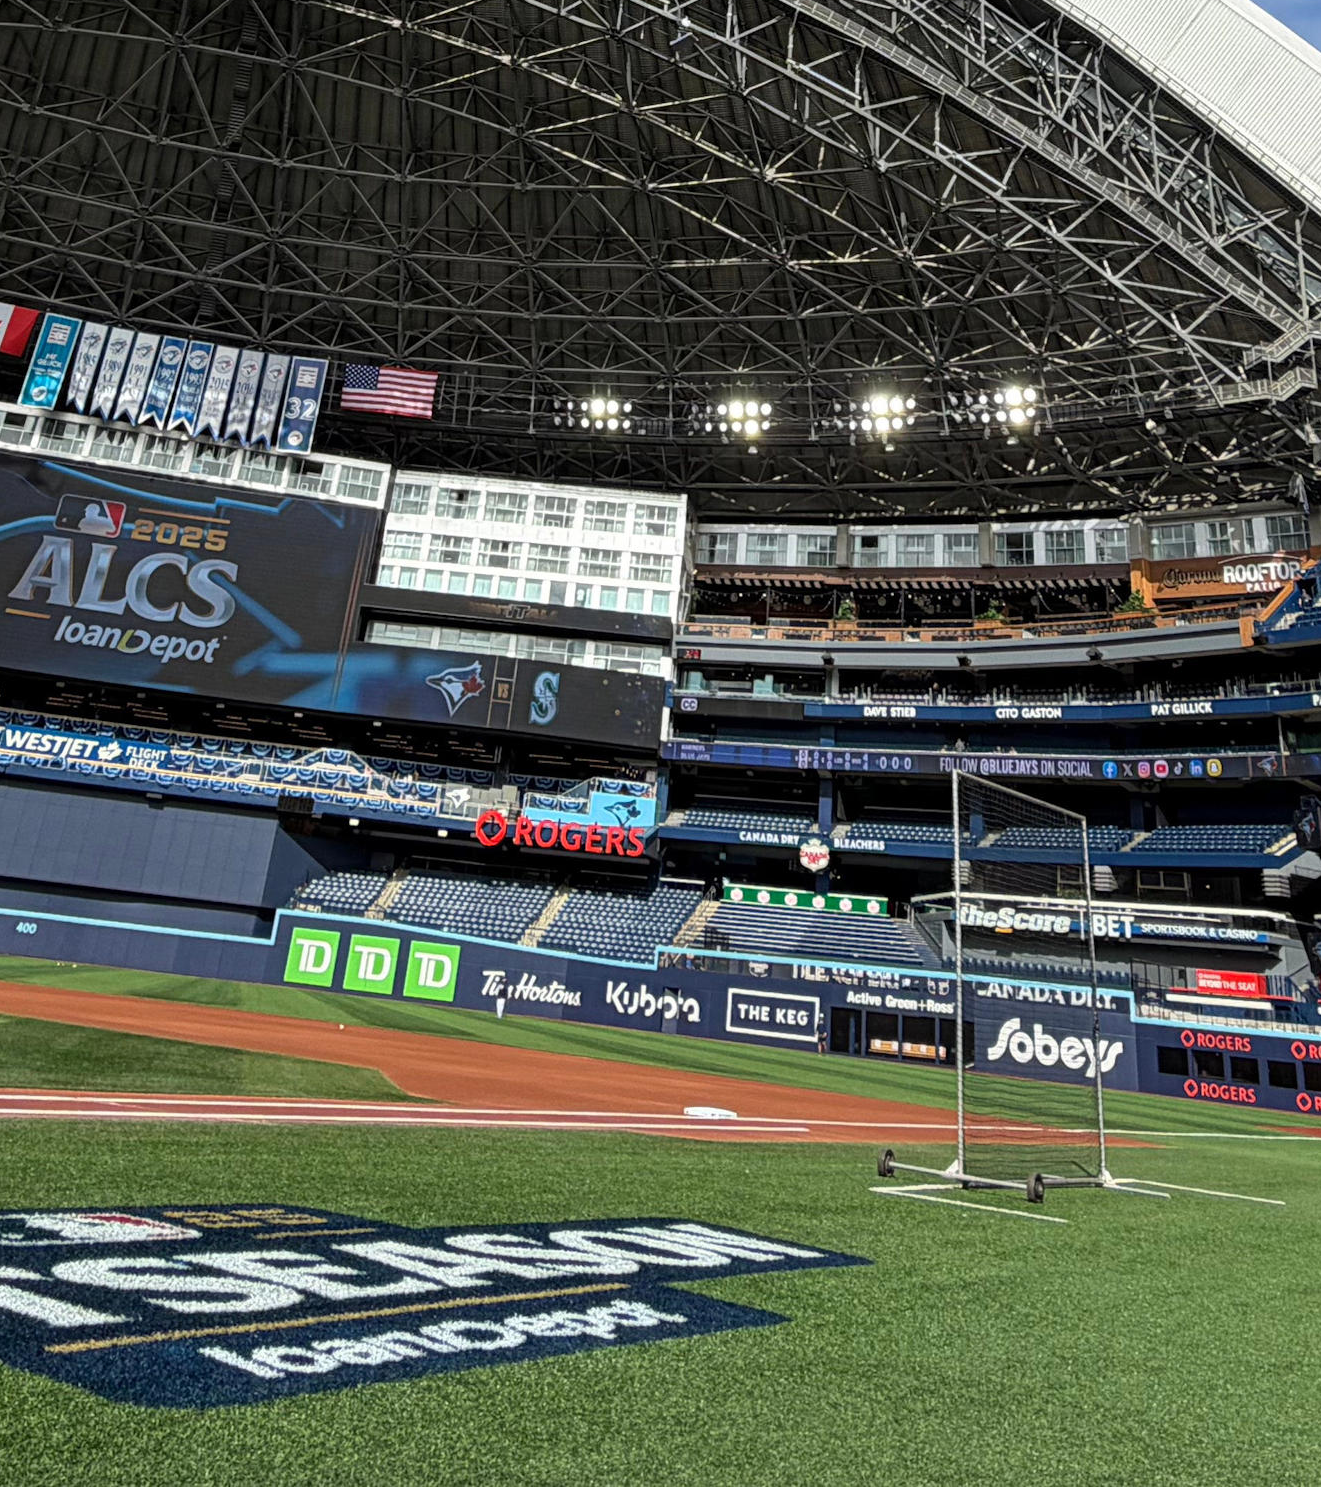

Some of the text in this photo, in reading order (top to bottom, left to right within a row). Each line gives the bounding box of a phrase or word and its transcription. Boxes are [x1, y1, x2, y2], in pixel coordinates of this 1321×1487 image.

[130, 363, 149, 378] 1991
[284, 396, 317, 421] 32
[131, 519, 230, 552] 2025
[8, 535, 239, 628] ALCS
[1223, 561, 1301, 584] ROOFTOP
[54, 616, 221, 663] loanDepot
[497, 682, 510, 699] VS
[682, 699, 697, 711] CC
[864, 706, 917, 719] DAVE STIEB
[995, 707, 1063, 719] CITO GASTON
[1151, 701, 1213, 716] PAT GILLICK
[5, 728, 100, 759] WESTJET
[125, 745, 169, 762] FLIGHT
[128, 758, 160, 770] DECK
[879, 756, 912, 770] 0 0 0
[940, 757, 1093, 777] FOLLOW @BLUEJAYS ON SOCIAL
[512, 816, 646, 857] ROGERS
[739, 830, 886, 851] CANADA DRY BLEACHERS
[15, 921, 38, 935] 400
[959, 903, 1258, 941] theScore BET SPORTSBOOK & CASINO
[295, 938, 332, 974] TD
[354, 944, 392, 982] TD
[414, 951, 452, 989] TD
[514, 972, 582, 1008] Hortons
[1222, 981, 1238, 991] THE
[1237, 981, 1257, 992] SEAT
[846, 990, 883, 1008] Active
[737, 1002, 811, 1027] THE KEG
[987, 1017, 1124, 1079] Sobeys
[1197, 1032, 1253, 1053] ROGERS
[1200, 1082, 1257, 1105] ROGERS
[198, 1299, 690, 1381] loanDepot
